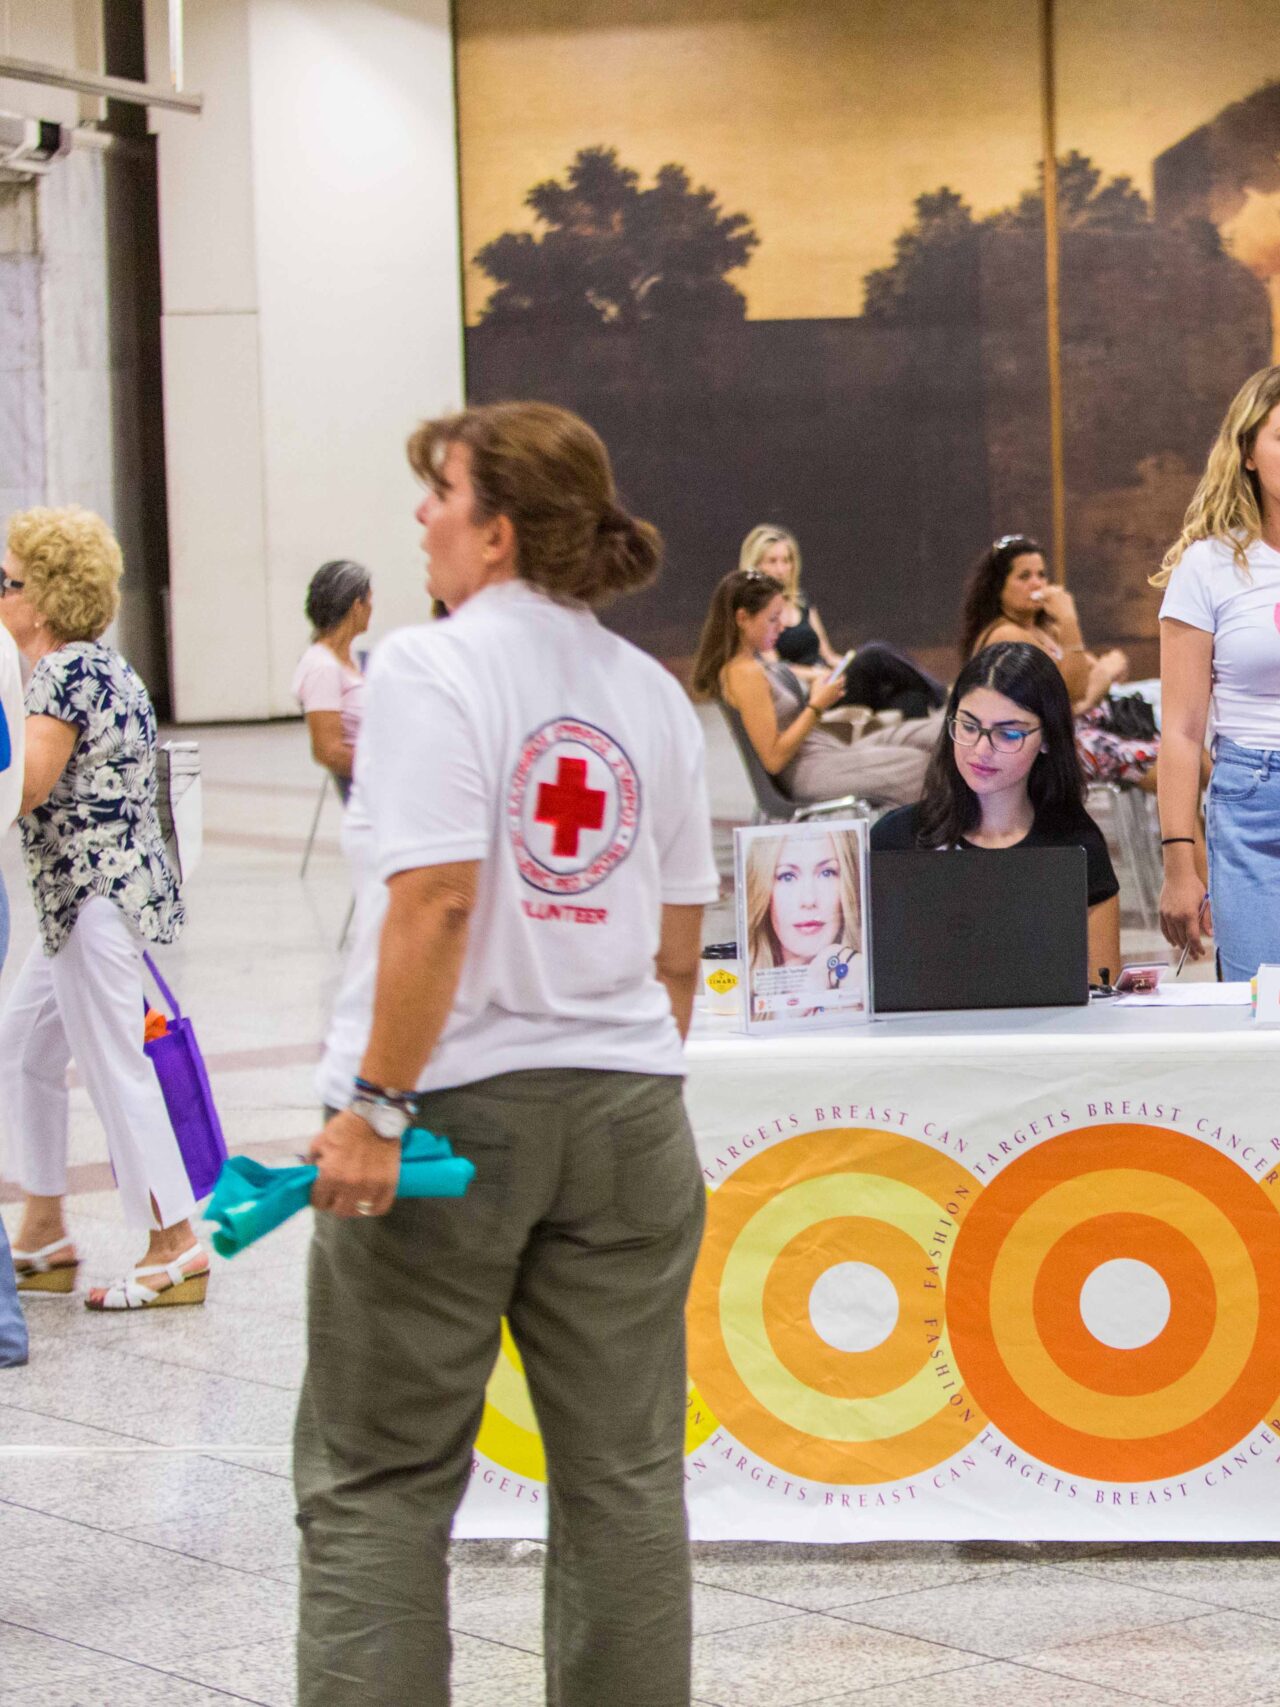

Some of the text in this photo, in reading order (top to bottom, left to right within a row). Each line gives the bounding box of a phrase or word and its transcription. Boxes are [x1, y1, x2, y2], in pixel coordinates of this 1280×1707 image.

[702, 1113, 800, 1180] TARGETS
[815, 1104, 909, 1126] BREAST
[923, 1184, 971, 1290] FASHION
[975, 1108, 1071, 1176] TARGETS
[1087, 1100, 1183, 1122] BREAST
[1196, 1117, 1280, 1187] CANCER
[710, 1434, 807, 1500] TARGETS
[824, 1485, 917, 1508] BREAST
[924, 1317, 975, 1424] FASHION
[978, 1431, 1078, 1499] TARGETS
[1096, 1483, 1188, 1507] BREAST
